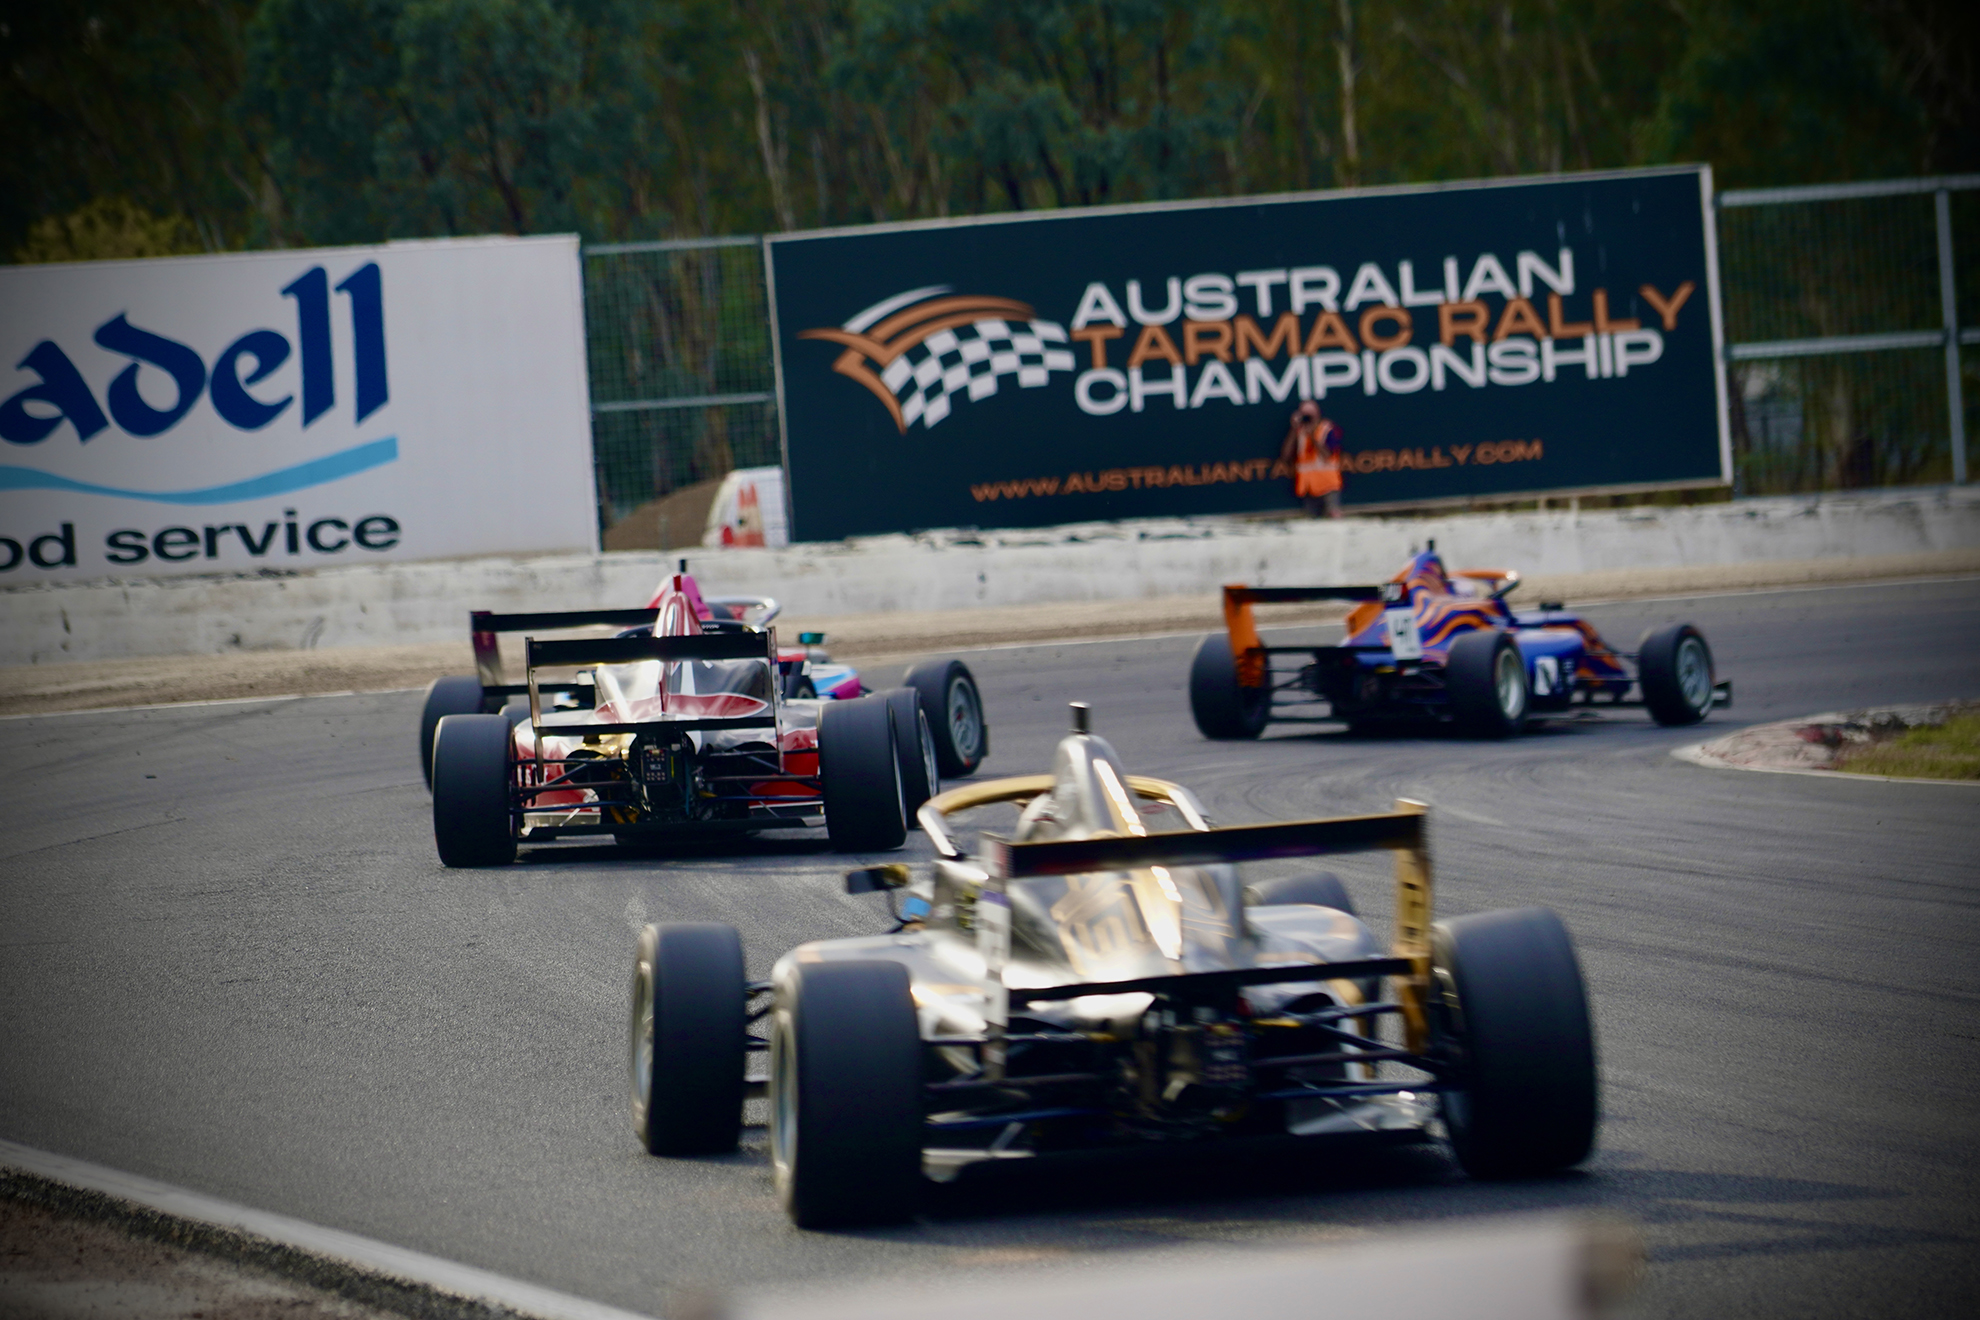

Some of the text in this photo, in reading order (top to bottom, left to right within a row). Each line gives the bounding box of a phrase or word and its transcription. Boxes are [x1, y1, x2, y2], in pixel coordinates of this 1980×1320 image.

[1070, 248, 1576, 331] AUSTRALIAN
[1070, 281, 1697, 369] TARMAC RALLY
[1073, 329, 1665, 416] CHAMPIONSHIP
[970, 438, 1544, 501] WWW.AUSTRALIANTAACRALLY.COM
[105, 508, 400, 565] service
